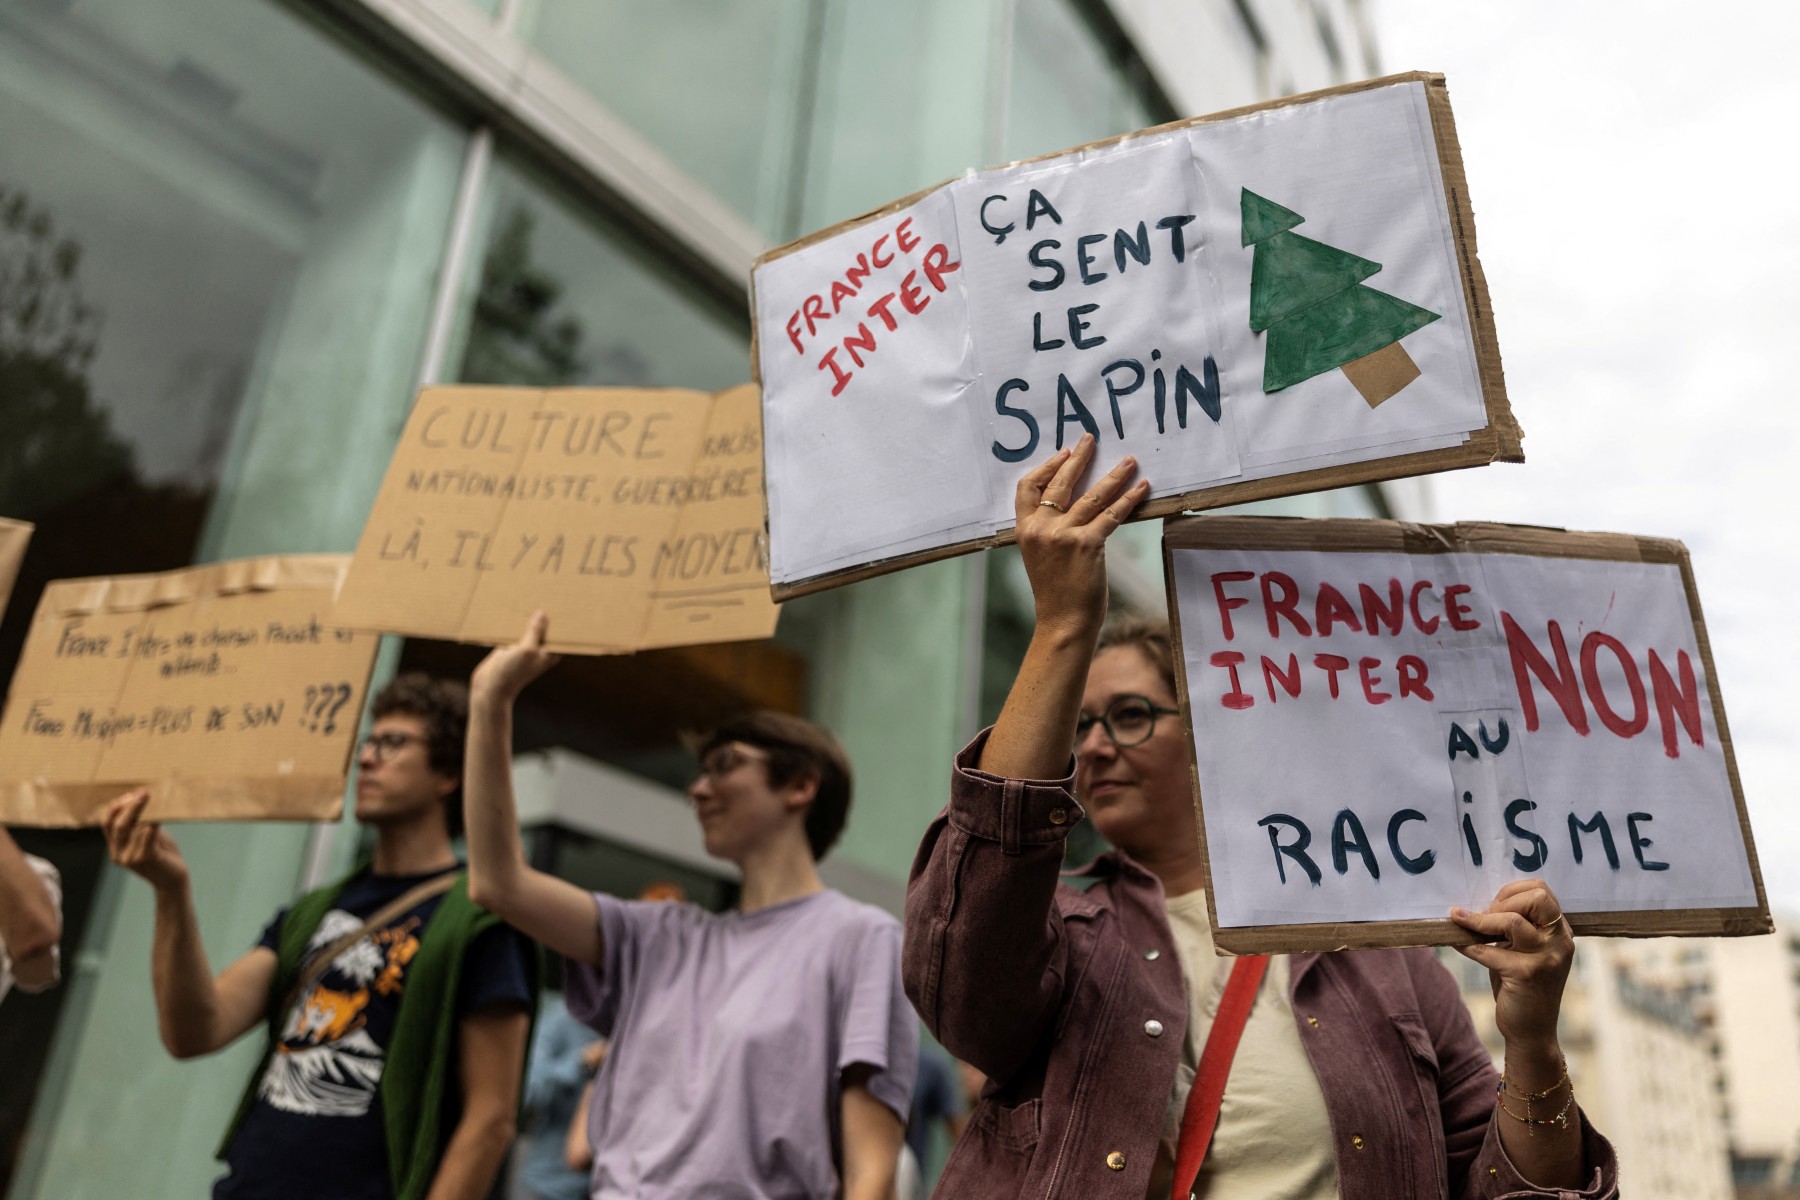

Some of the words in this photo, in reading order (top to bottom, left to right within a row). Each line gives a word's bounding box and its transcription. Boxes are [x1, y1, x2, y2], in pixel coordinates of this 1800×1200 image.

[980, 189, 1062, 244] ÇA
[1028, 214, 1196, 292] SENT
[786, 217, 922, 355] FRANCE
[818, 243, 961, 396] INTER
[1033, 303, 1107, 352] LE
[419, 404, 672, 460] CULTURE
[379, 516, 430, 571] LÀ,
[448, 529, 495, 571] IL
[511, 532, 539, 571] Y
[538, 532, 566, 574] A
[578, 534, 640, 579] LES
[1210, 570, 1482, 642] FRANCE
[299, 681, 353, 737] ???
[1209, 650, 1435, 711] INTER
[1500, 609, 1705, 760] NON
[1448, 717, 1511, 761] AU
